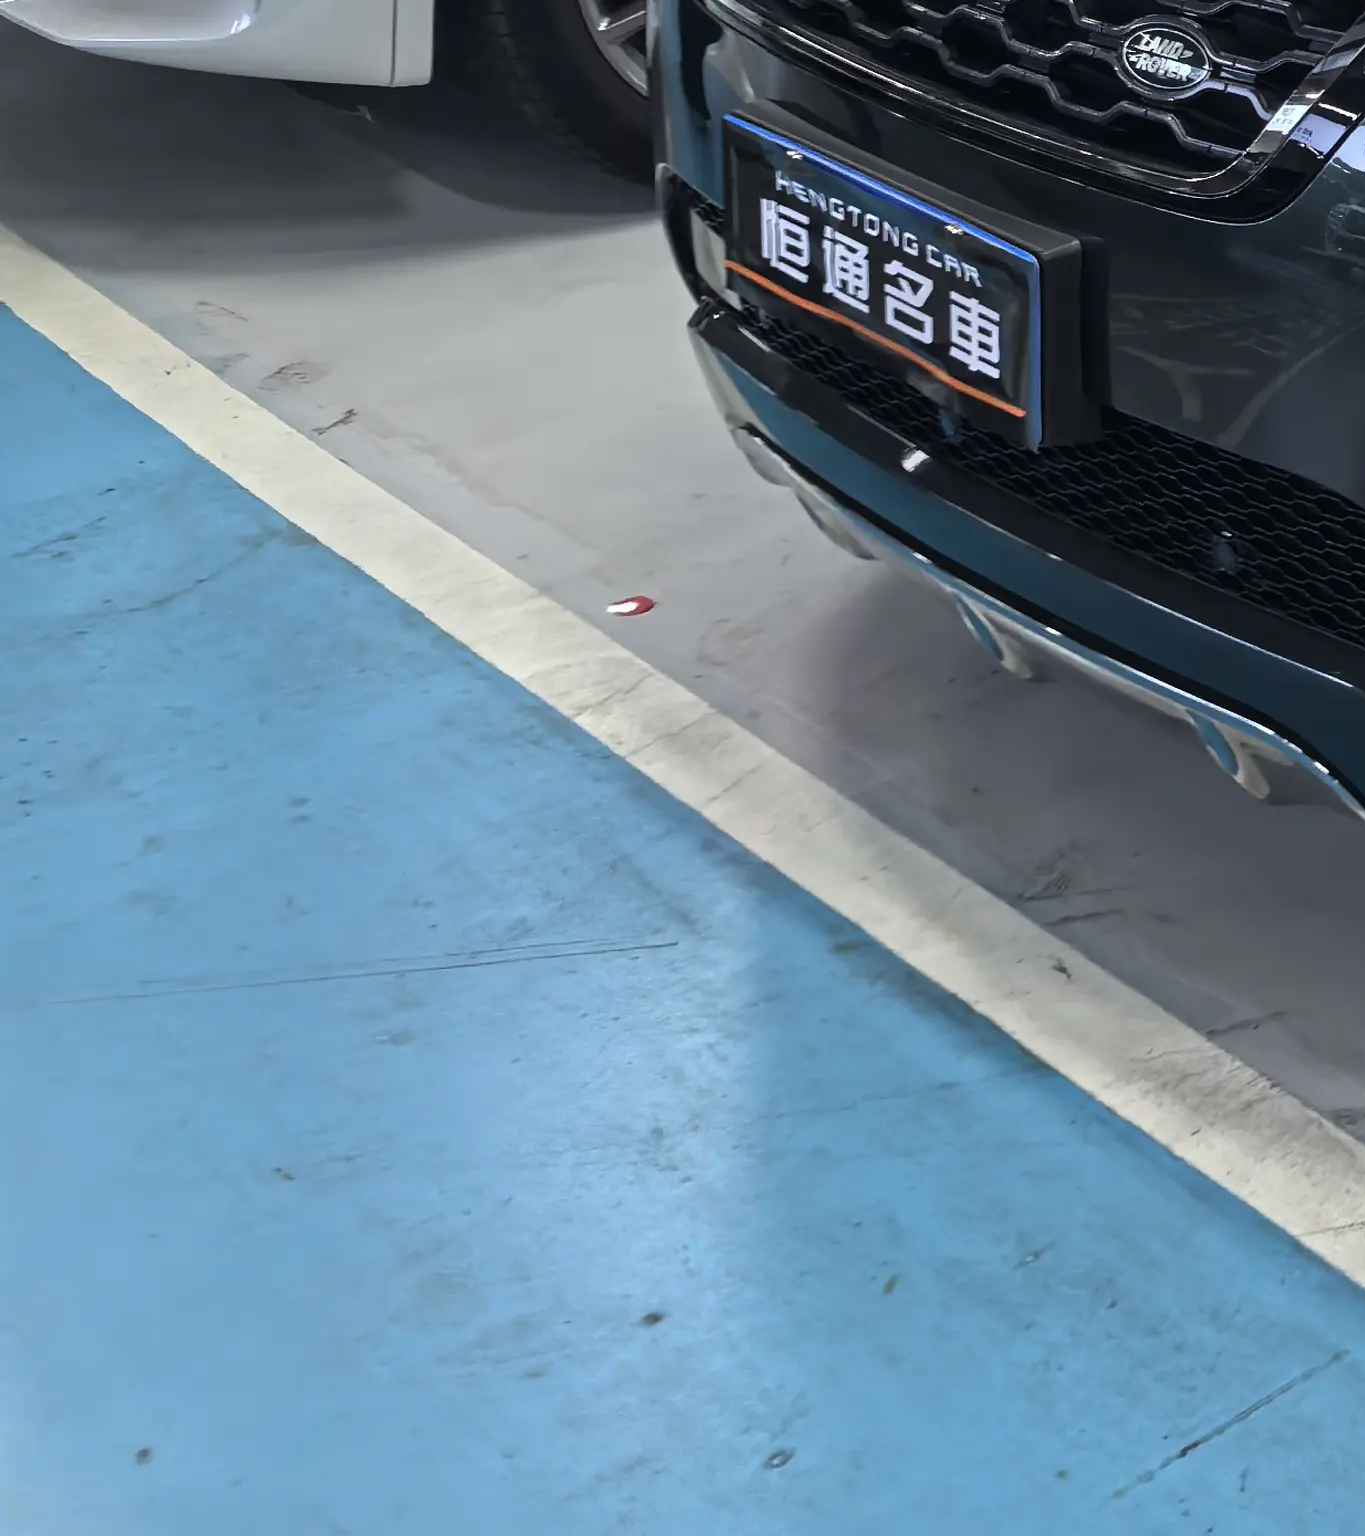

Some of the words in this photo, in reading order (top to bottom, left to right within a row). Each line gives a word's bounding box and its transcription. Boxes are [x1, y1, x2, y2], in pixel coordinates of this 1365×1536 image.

[1135, 33, 1184, 59] LAND
[1136, 53, 1192, 82] ROVER
[775, 169, 920, 256] HENGTONG
[925, 245, 983, 288] CAR
[759, 197, 1001, 380] 恒通名車
